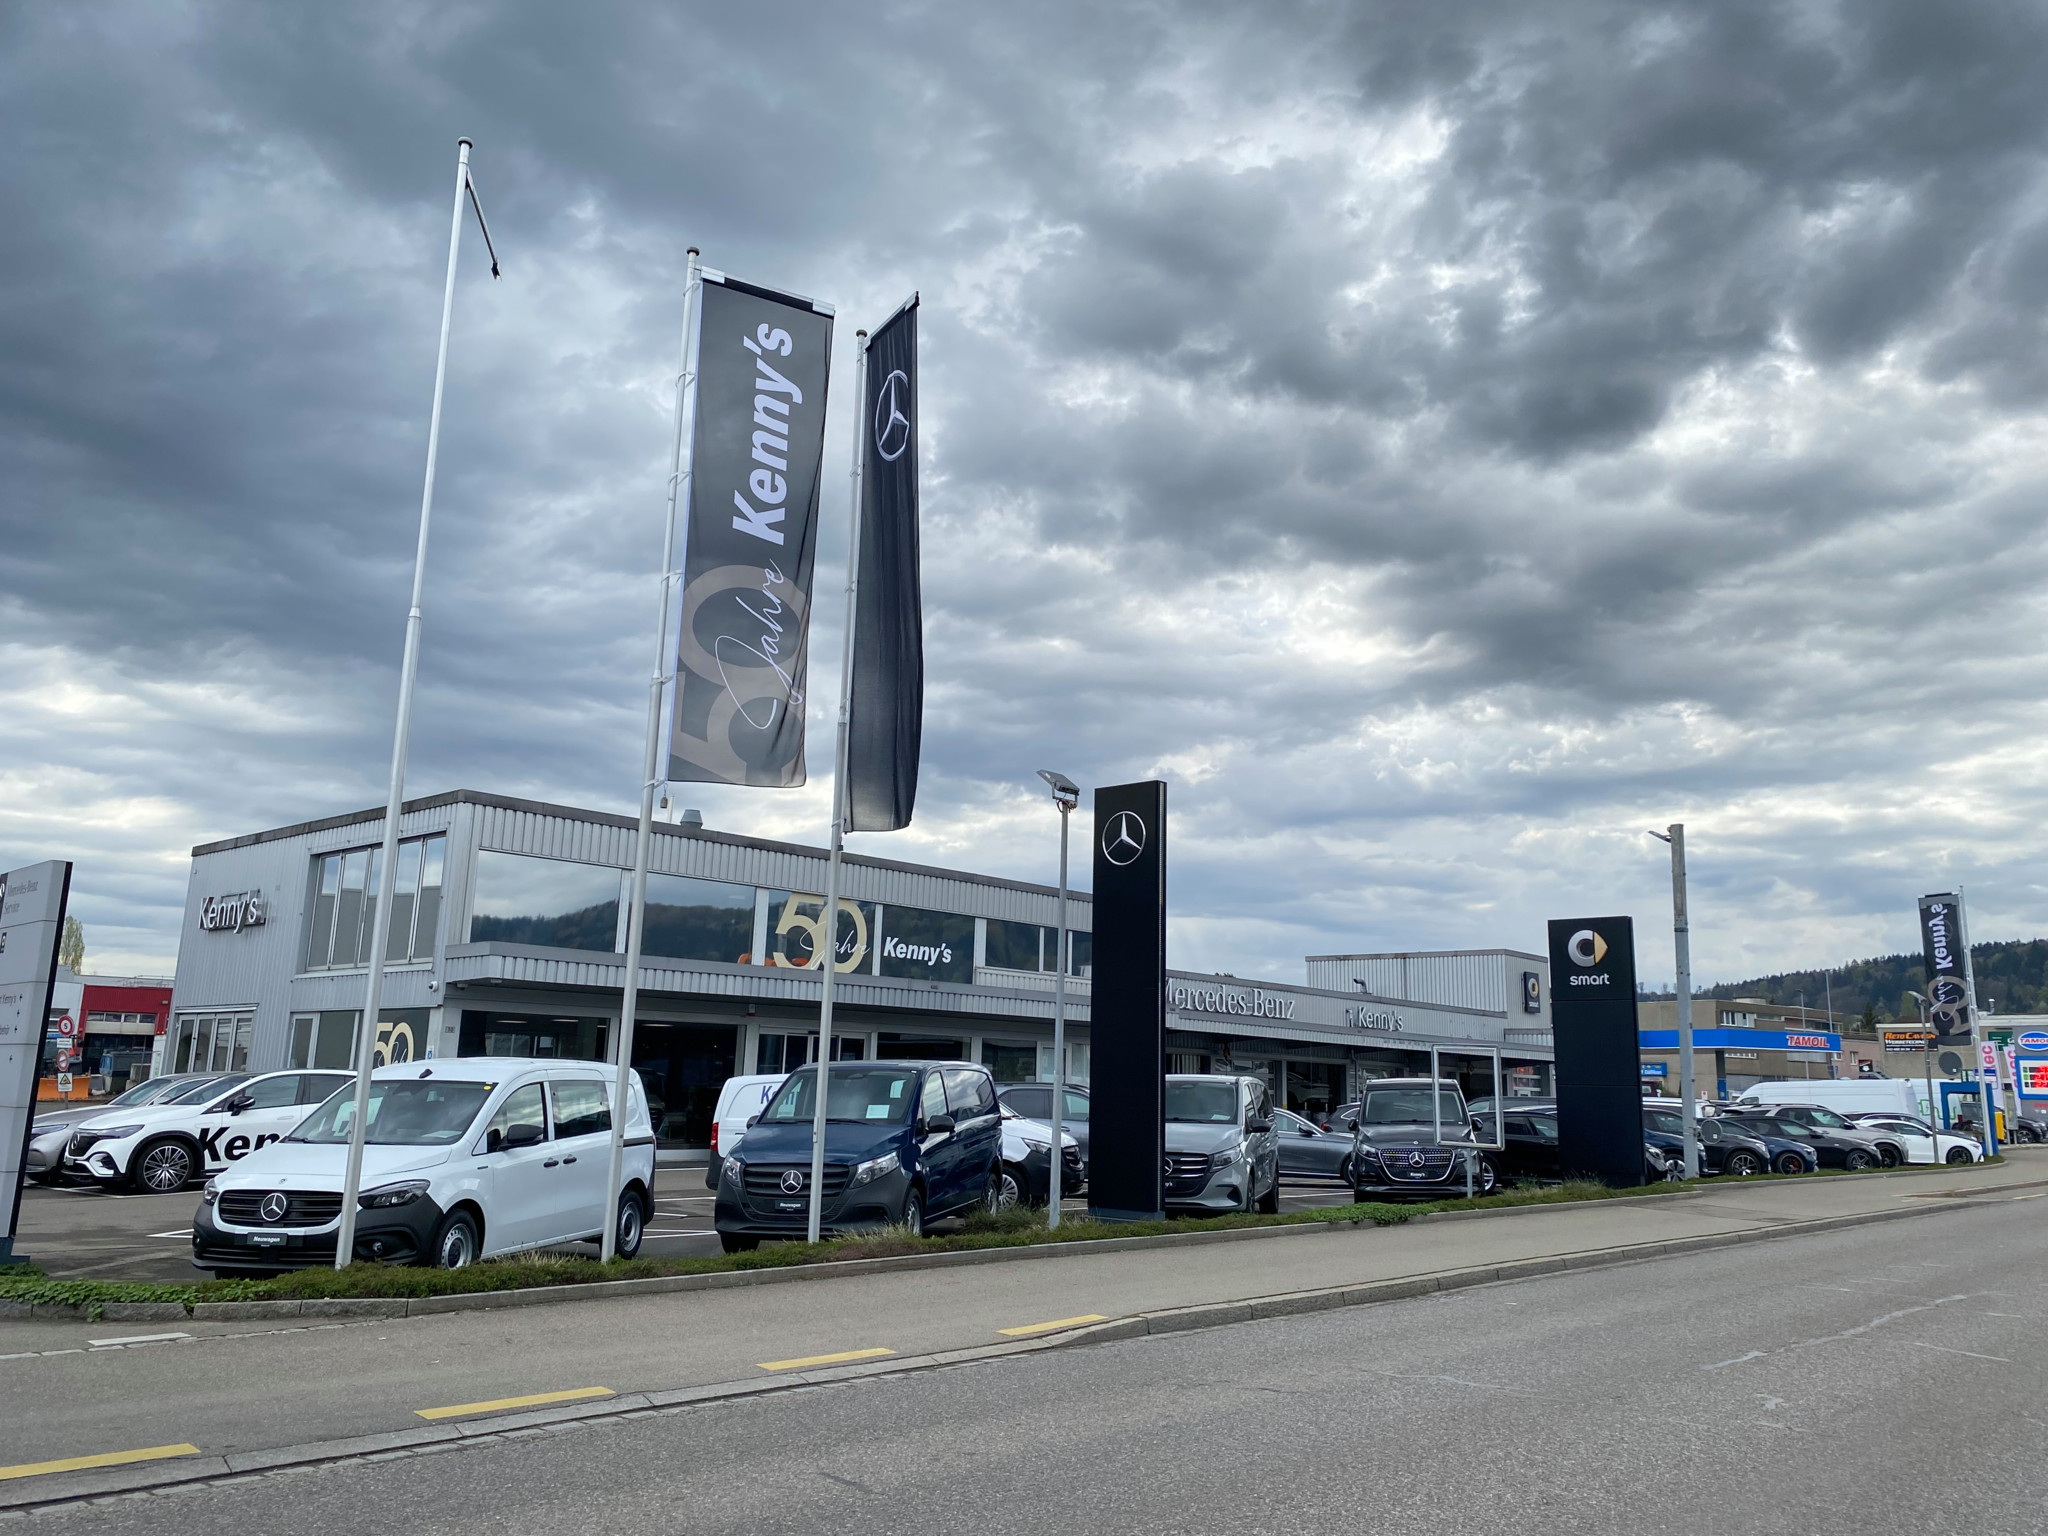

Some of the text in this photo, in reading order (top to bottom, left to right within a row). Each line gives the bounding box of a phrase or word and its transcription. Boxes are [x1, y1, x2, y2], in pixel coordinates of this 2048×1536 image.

[732, 322, 803, 546] Kenny's
[714, 559, 803, 730] Jahre
[198, 889, 259, 934] Kenny's
[772, 893, 868, 974] 50
[883, 936, 953, 966] Kenny's
[1165, 977, 1296, 1020] Mercedes-Benz
[1569, 973, 1610, 986] smart
[1358, 1006, 1404, 1031] Kenny's
[1786, 1034, 1830, 1048] TAMOIL
[253, 1235, 281, 1244] Neuwagen
